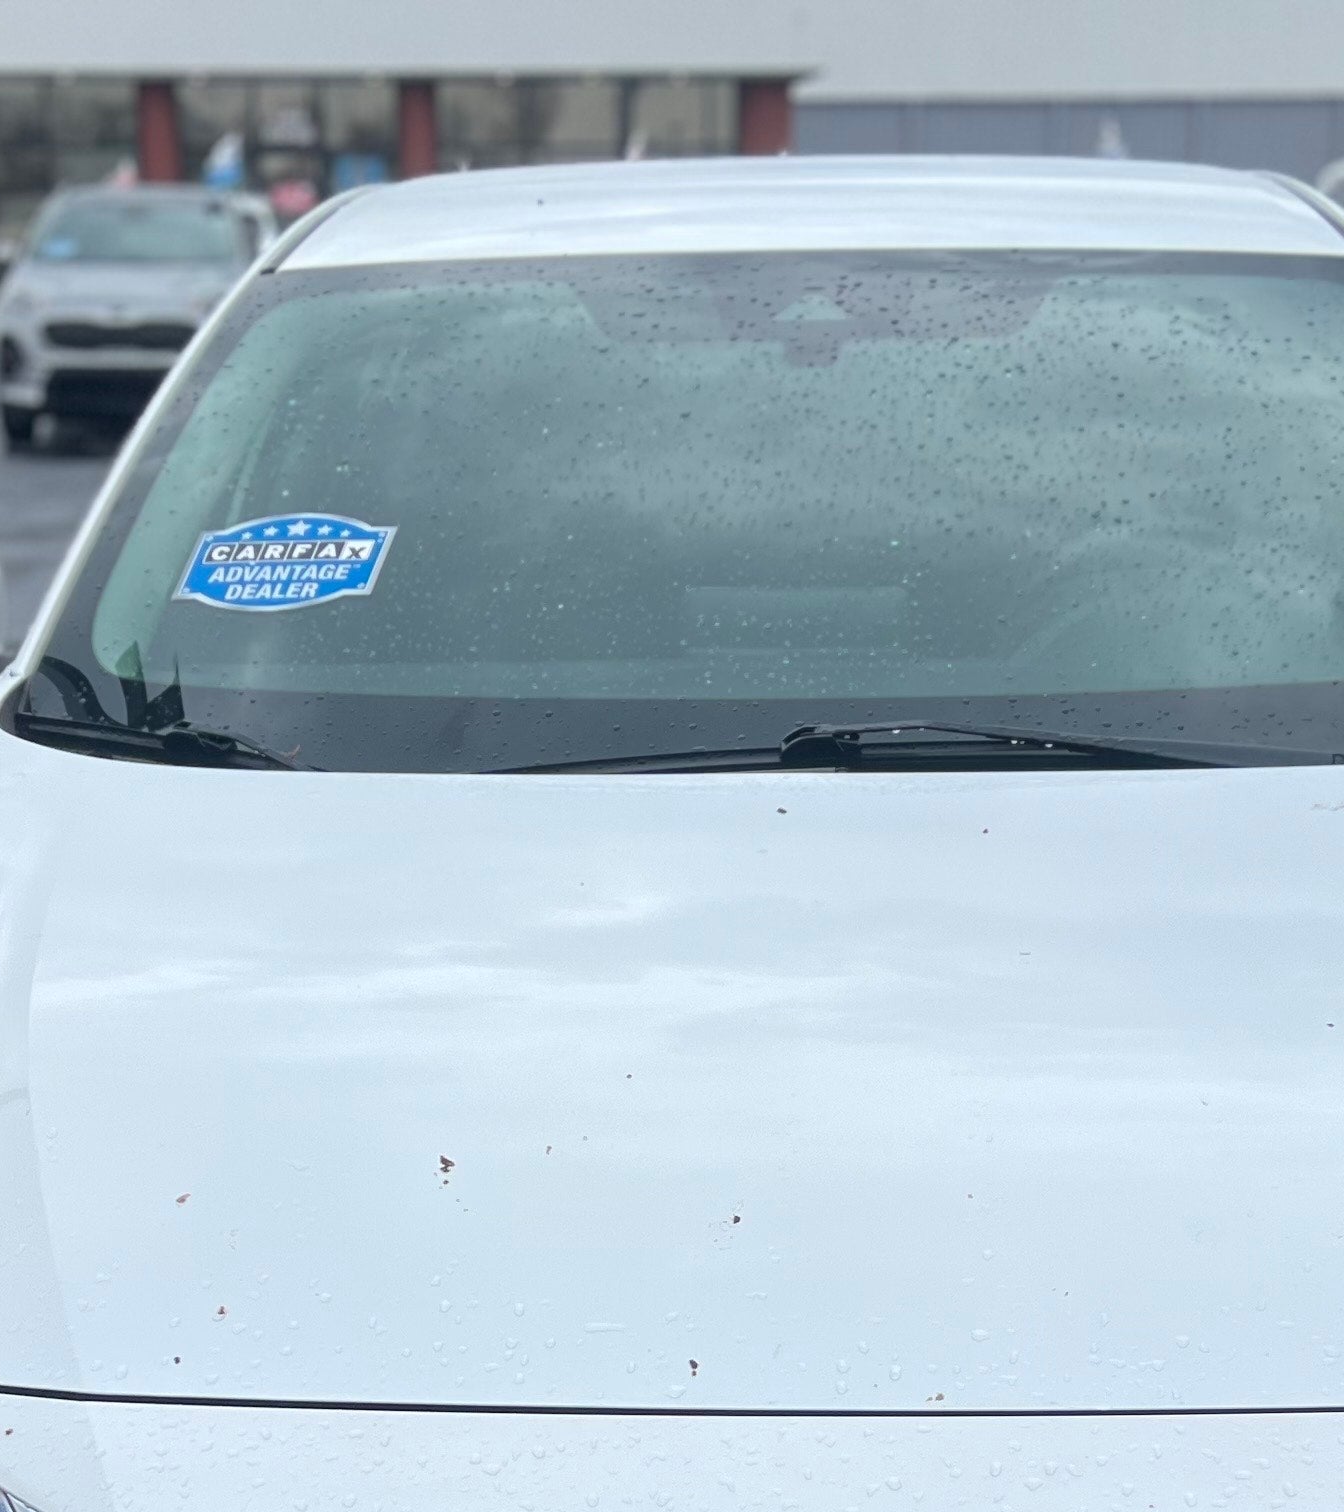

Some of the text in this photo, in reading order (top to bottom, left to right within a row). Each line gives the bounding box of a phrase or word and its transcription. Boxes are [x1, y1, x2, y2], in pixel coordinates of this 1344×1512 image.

[209, 544, 368, 562] CARFAX
[208, 564, 350, 583] ADVANTAGE
[225, 583, 319, 600] DEALER
